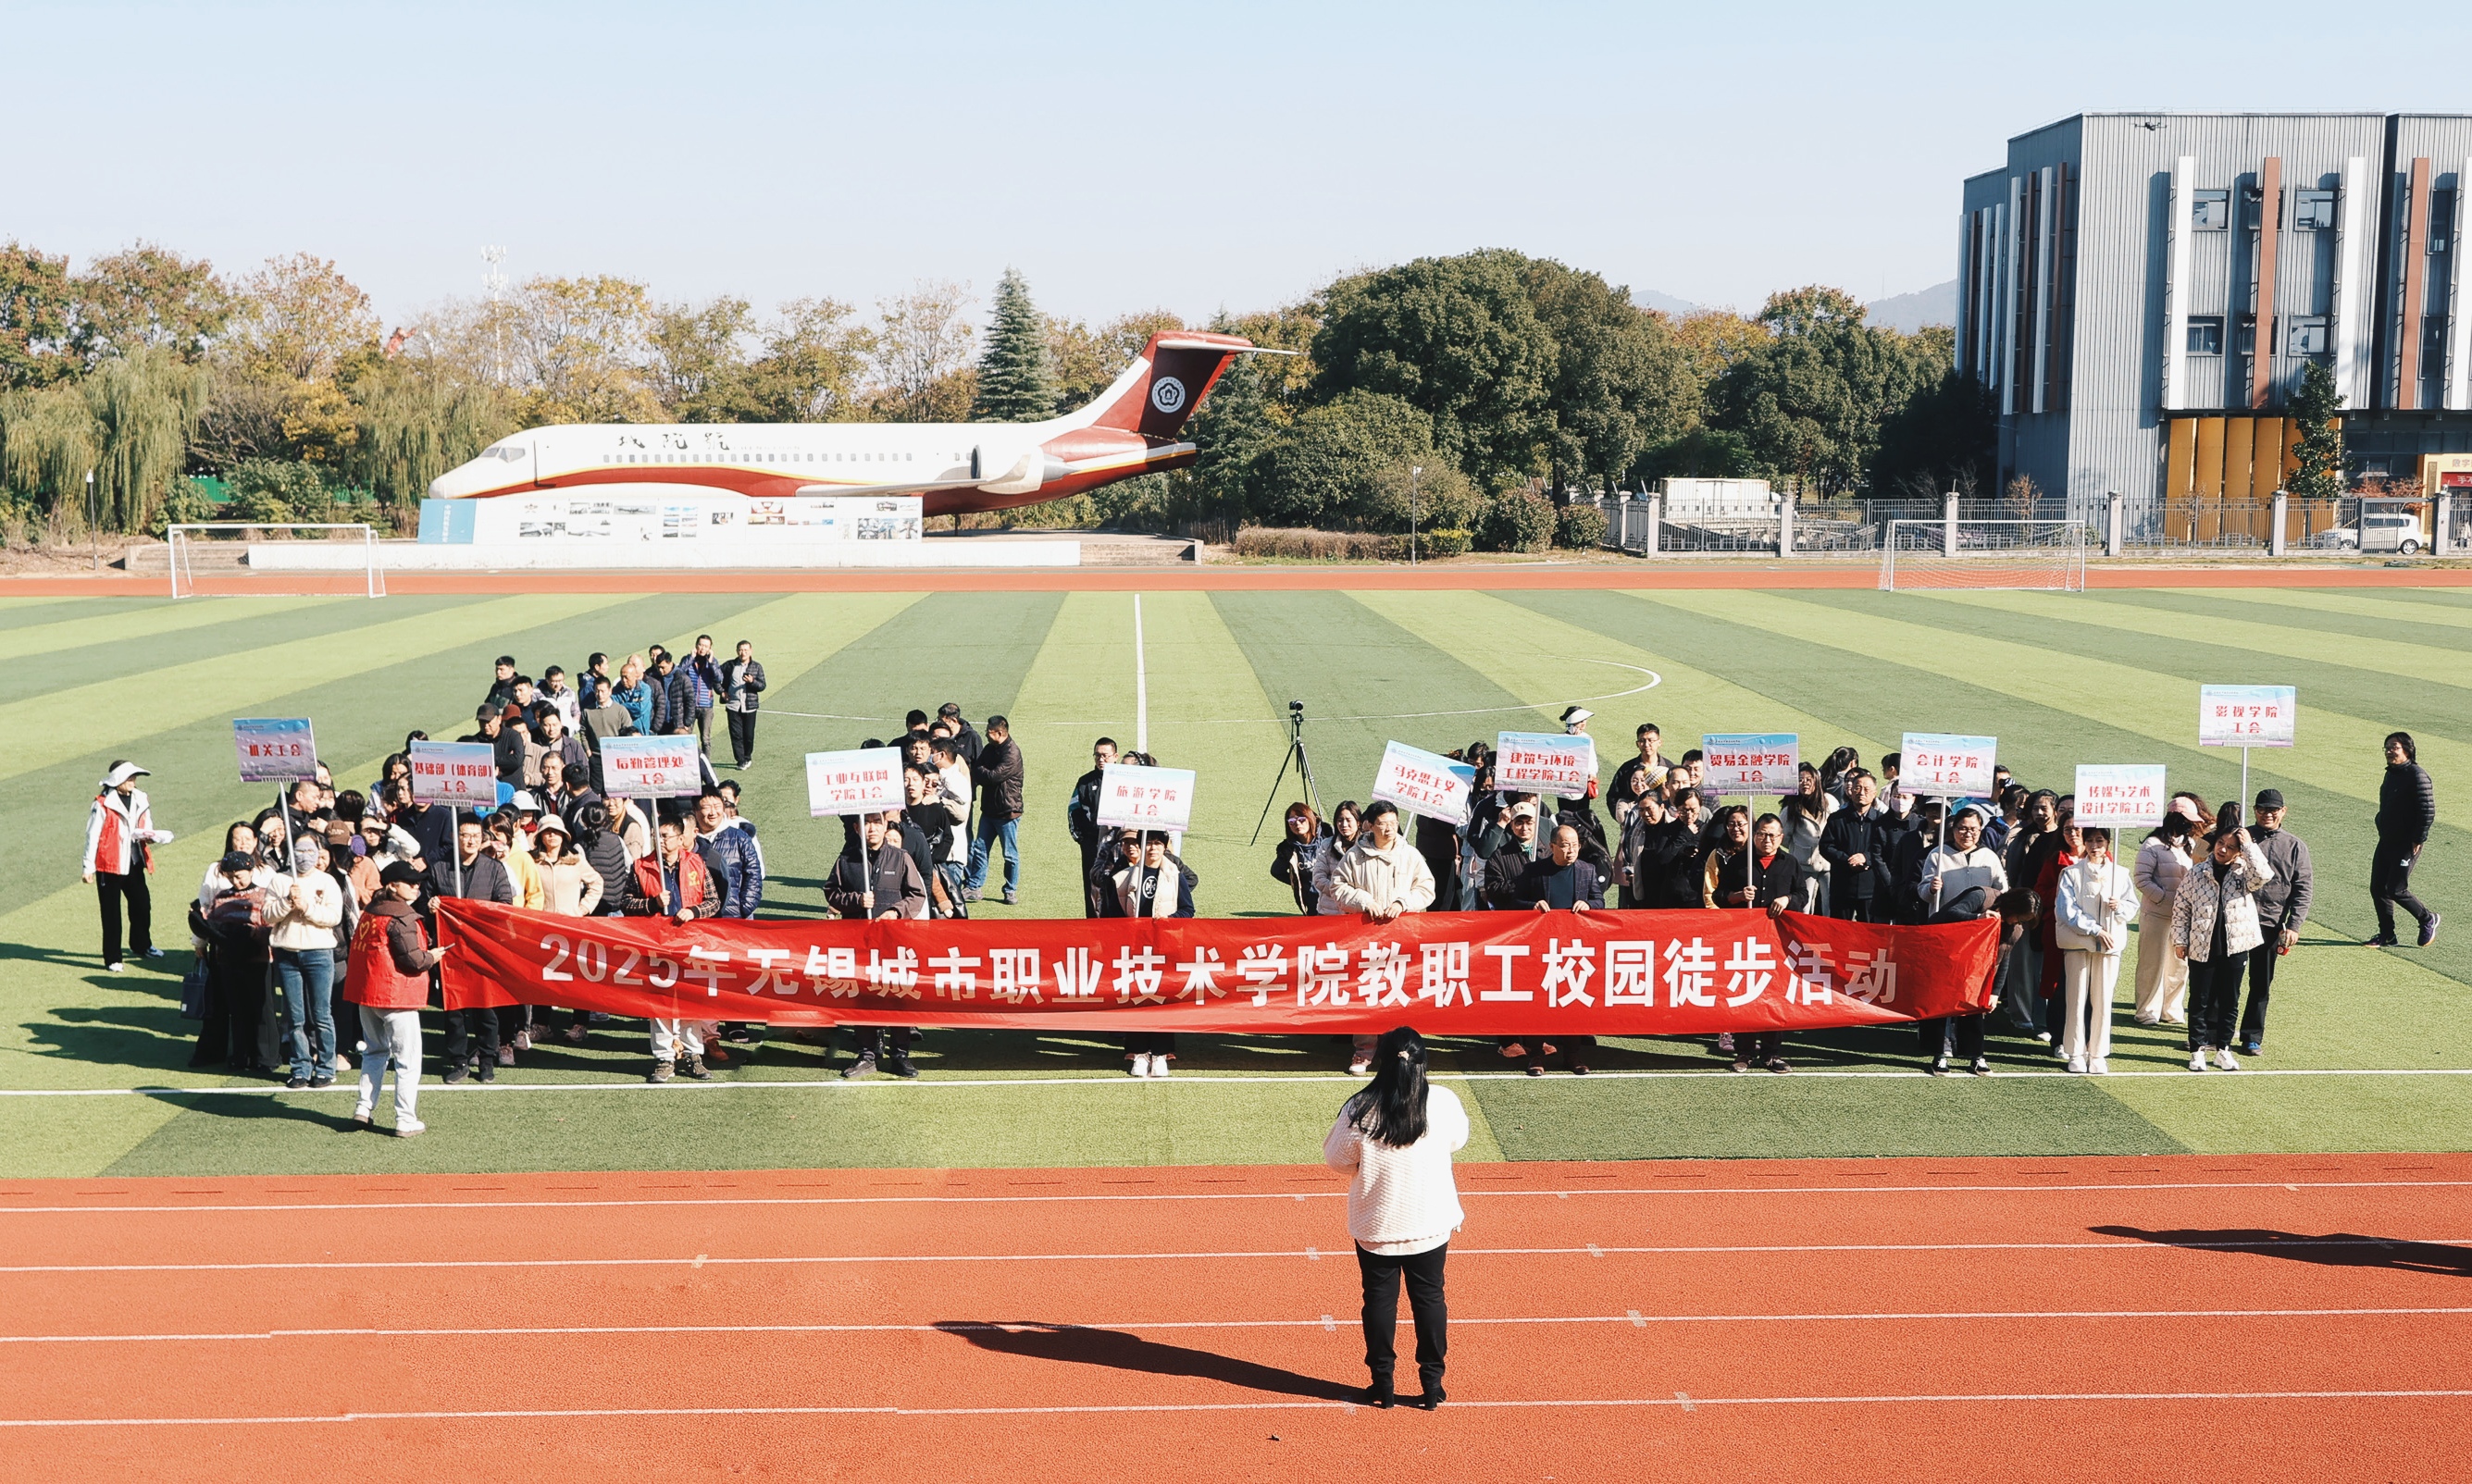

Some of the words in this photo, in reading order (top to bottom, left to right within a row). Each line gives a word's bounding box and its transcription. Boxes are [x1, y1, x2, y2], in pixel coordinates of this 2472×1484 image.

[2216, 706, 2278, 718] 影视学院
[2234, 722, 2261, 734] 工会
[249, 744, 301, 757] 机关工会
[616, 755, 684, 770] 后勤管理处
[1510, 752, 1575, 767] 建筑与环境
[1710, 753, 1790, 767] 贸易金融学院
[1917, 753, 1978, 769] 会计学院
[640, 773, 665, 785] 工会
[823, 770, 888, 785] 工业互联网
[1395, 764, 1456, 793] 马克思主义
[1503, 767, 1581, 782] 工程学院工会
[1737, 770, 1763, 783] 工会
[1932, 771, 1959, 784] 工会
[441, 780, 466, 793] 工会
[829, 786, 882, 801] 学院工会
[1116, 785, 1176, 801] 旅游学院
[2089, 786, 2150, 798] 传媒与艺术
[1396, 782, 1444, 806] 学院工会
[1132, 803, 1160, 816] 工会
[2081, 801, 2156, 814] 设计学院工会
[540, 934, 1897, 1008] 2025年无锡城市职业技术学院教职工校园徒步活动
